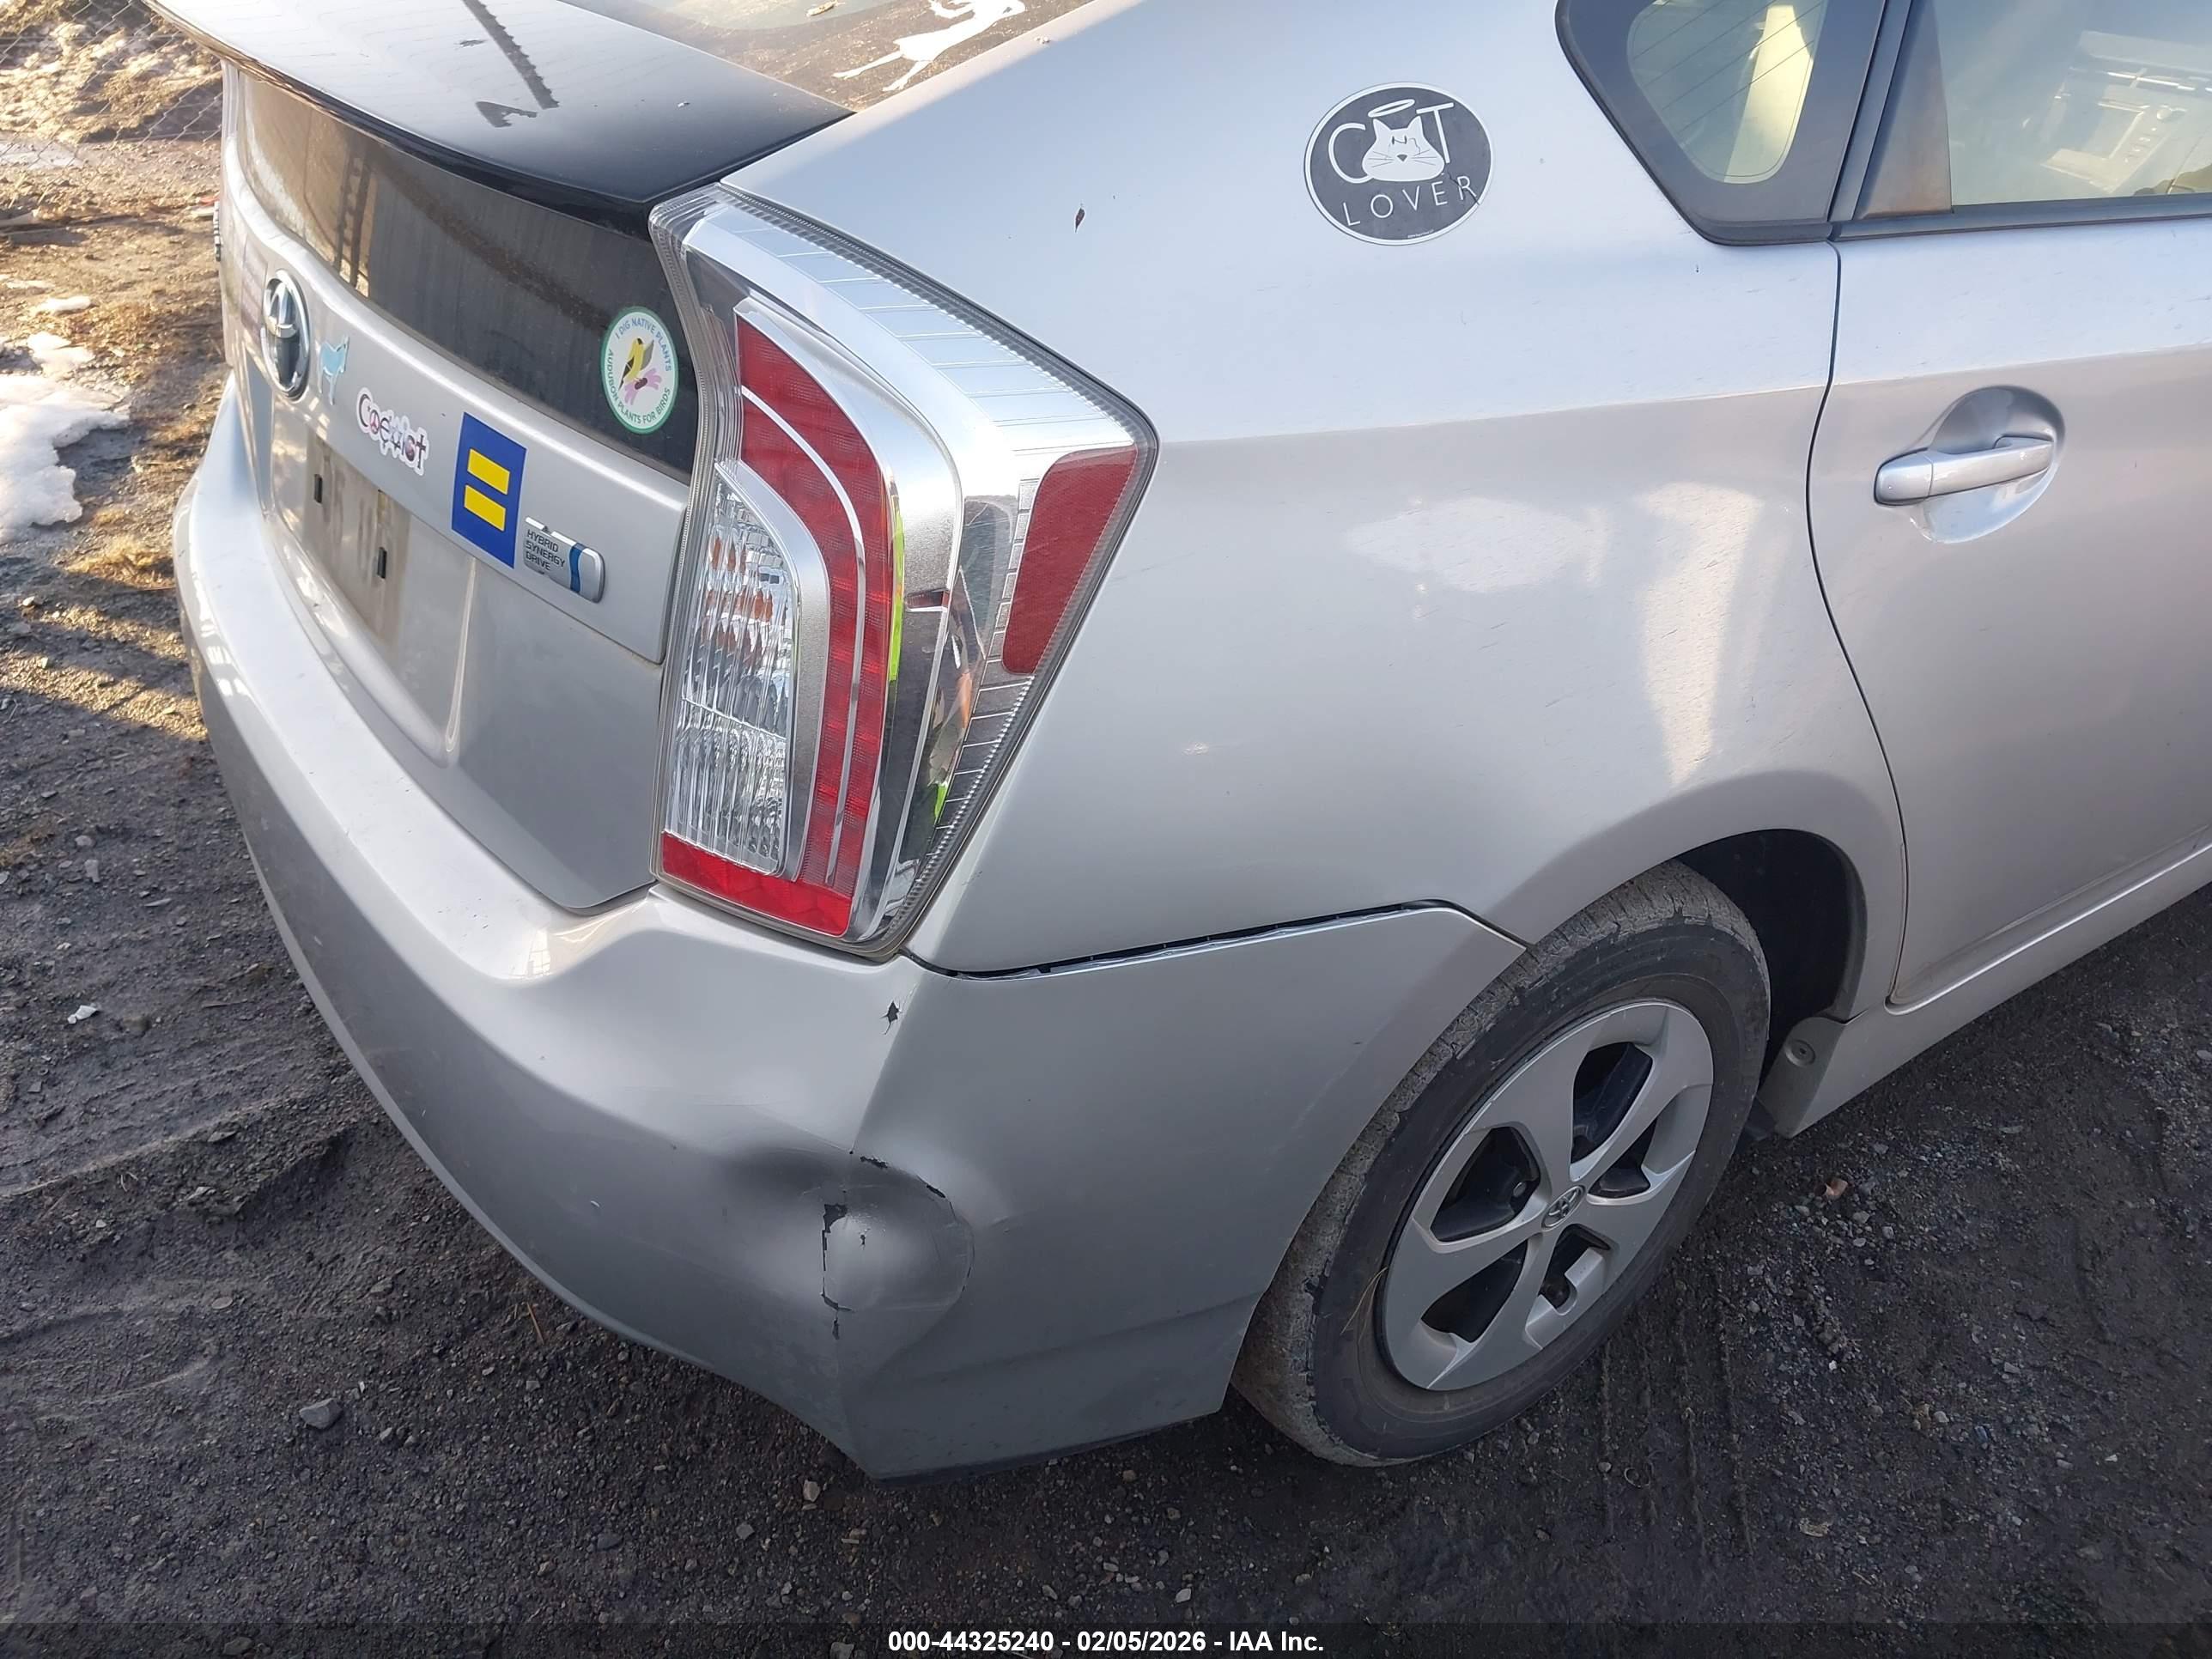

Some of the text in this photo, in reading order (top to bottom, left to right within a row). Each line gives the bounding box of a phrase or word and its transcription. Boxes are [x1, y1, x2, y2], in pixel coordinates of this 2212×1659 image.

[1343, 175, 1477, 227] LOVER
[619, 320, 631, 336] DIG
[631, 317, 656, 333] NATIVE
[656, 331, 672, 372] PLANTS
[606, 348, 671, 424] AUDUBON PLANTS FOR BIRDS
[526, 529, 559, 553] HYBRID
[526, 540, 566, 568] SYNERGY
[526, 551, 551, 571] DRIVE
